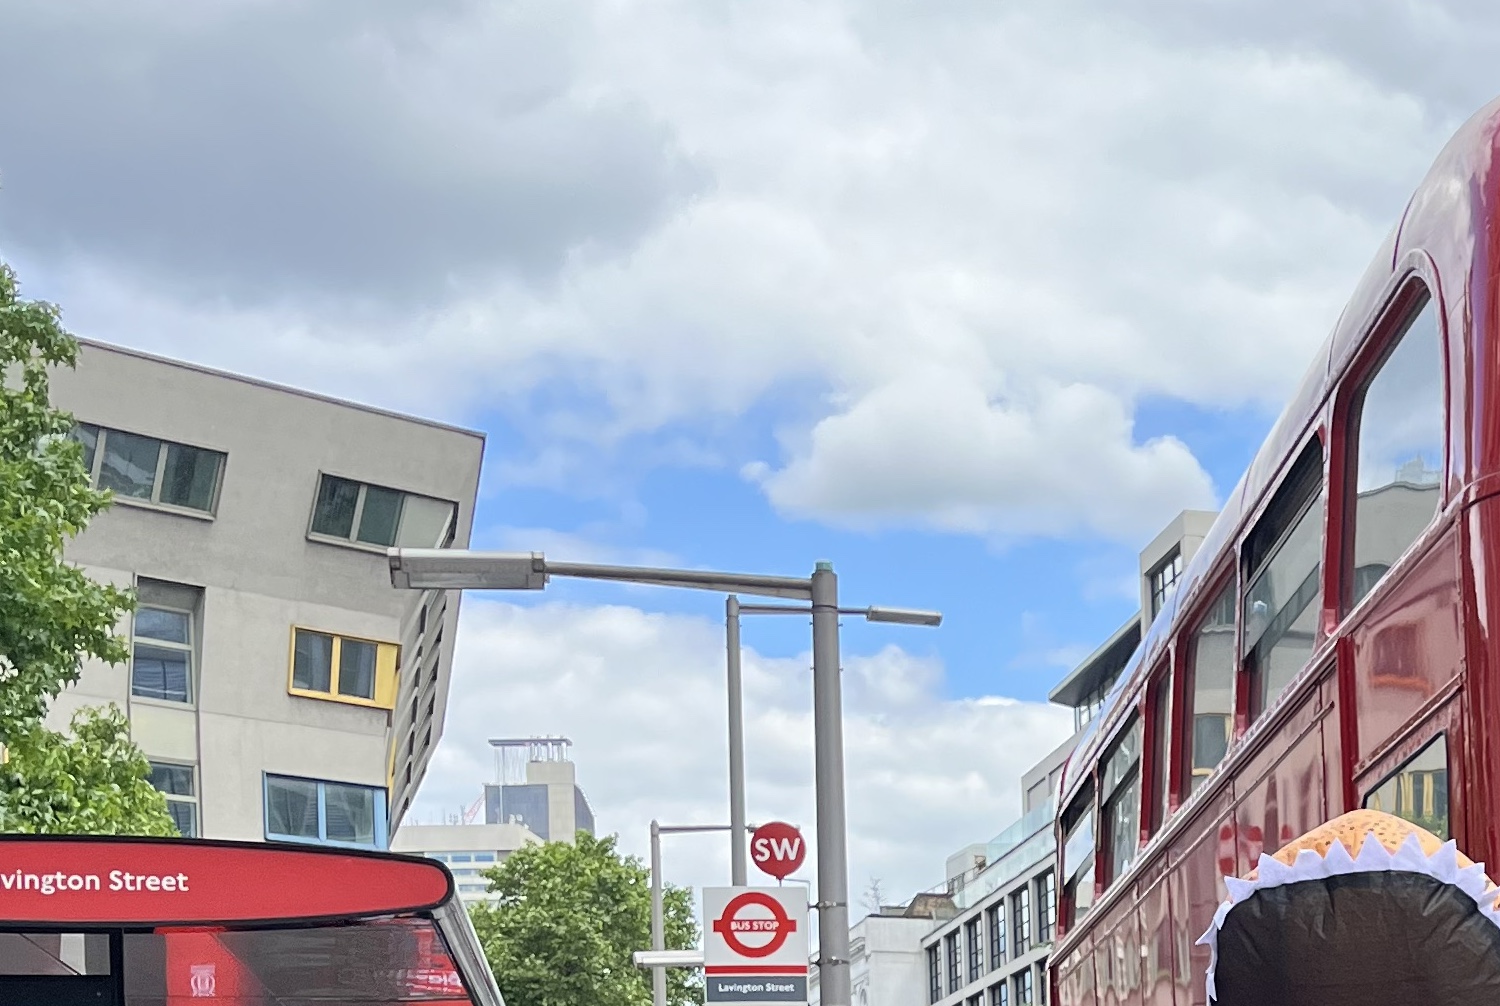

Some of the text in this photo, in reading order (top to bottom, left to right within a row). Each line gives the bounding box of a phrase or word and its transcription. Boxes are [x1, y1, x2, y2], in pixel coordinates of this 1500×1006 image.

[754, 837, 801, 862] SW
[109, 870, 190, 892] Street
[730, 920, 779, 931] BUS STOP
[718, 982, 795, 993] Lavington Street
